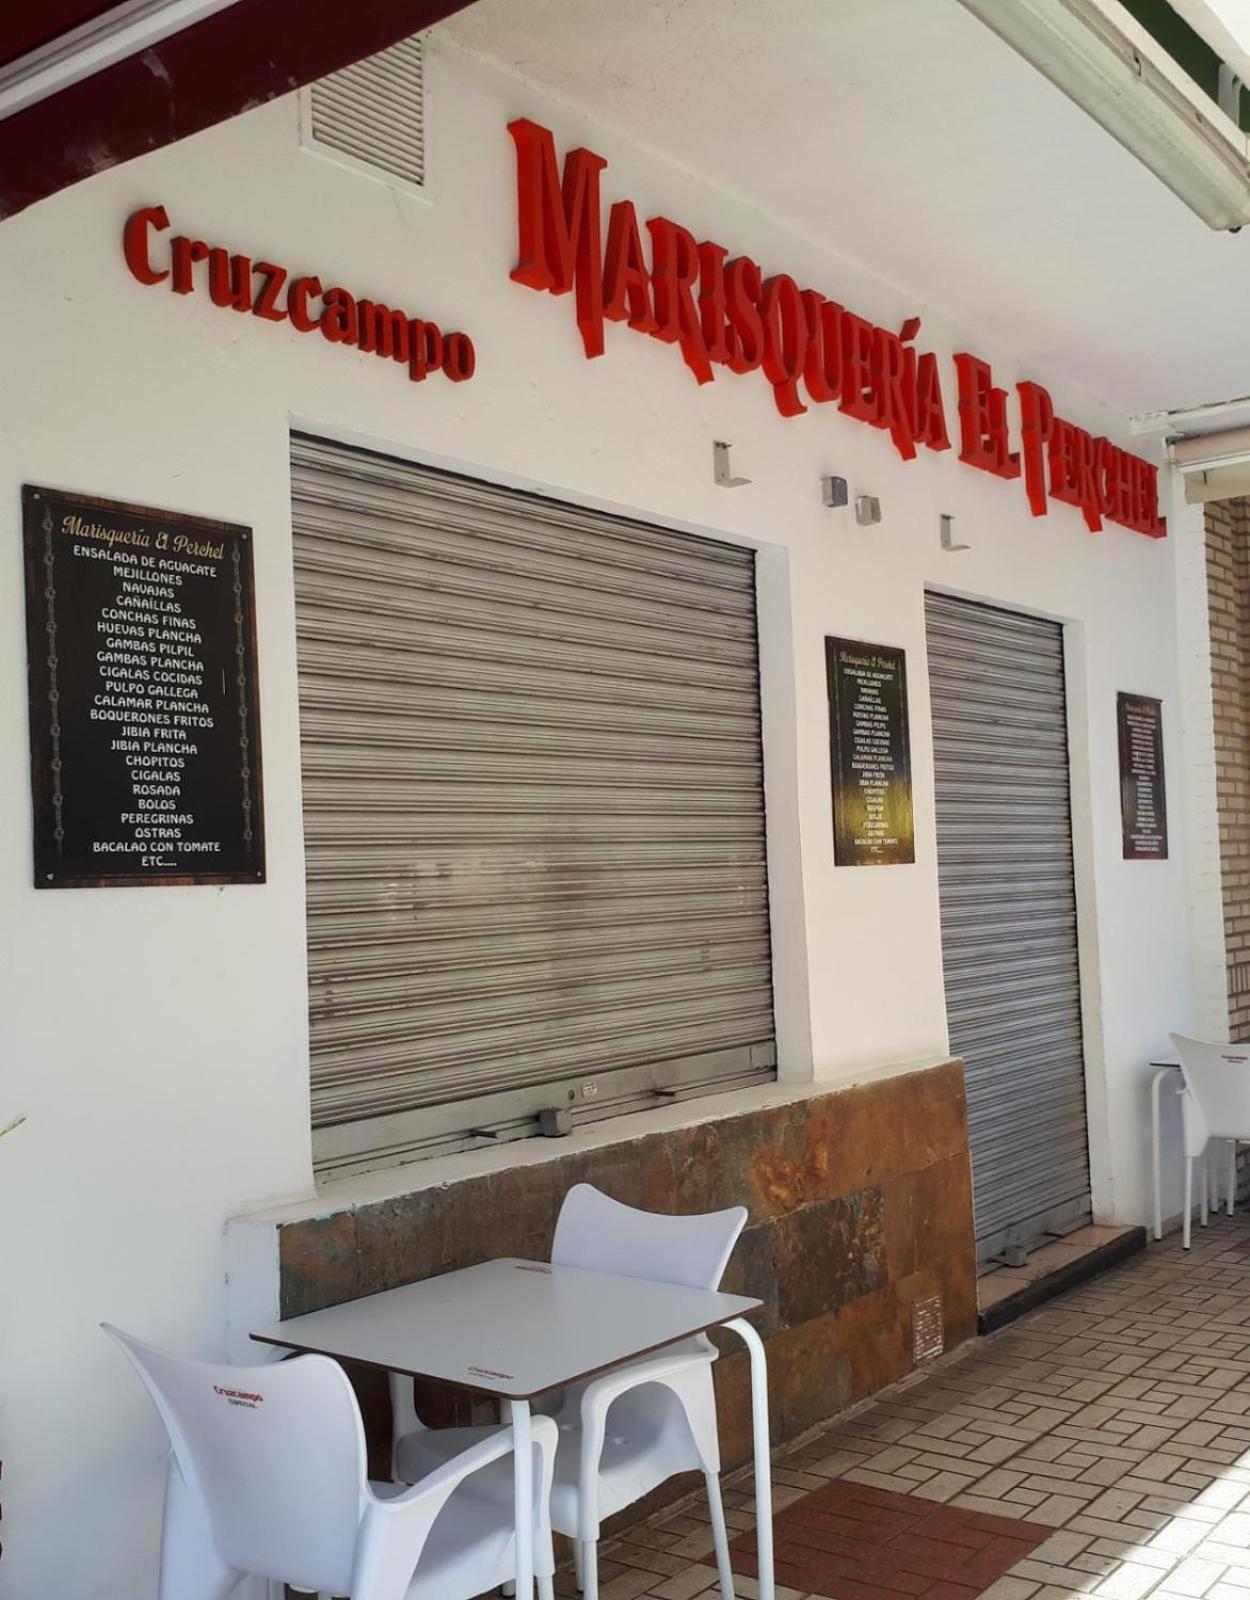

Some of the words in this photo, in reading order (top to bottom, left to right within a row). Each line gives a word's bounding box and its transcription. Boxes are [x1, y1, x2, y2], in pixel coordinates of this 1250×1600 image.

[123, 206, 475, 383] Cruzcampo
[507, 118, 951, 460] MARISQUERÍA
[1016, 381, 1167, 539] PERCHEL
[61, 515, 150, 548] Marisquería
[173, 535, 224, 560] Perchel
[73, 545, 138, 565] ENSALADA
[141, 556, 156, 568] DE
[159, 560, 217, 578] AGUACATE
[113, 566, 183, 586] MEJILLONES
[122, 582, 175, 599] NAVAJAS
[101, 608, 159, 624] CONCHAS
[162, 616, 196, 630] FINAS
[97, 621, 145, 637] HUEVAS
[148, 627, 202, 644] PLANCHA
[106, 637, 156, 652] GAMBAS
[159, 643, 195, 657] PILPIL
[96, 651, 147, 666] GAMBAS
[150, 656, 204, 672] PLANCHA
[99, 666, 150, 681] CIGALAS
[153, 671, 203, 685] COCIDAS
[106, 681, 145, 694] PULPO
[147, 685, 198, 698] GALLEGA
[94, 695, 153, 709] CALAMAR
[155, 700, 210, 714] PLANCHA
[90, 709, 171, 725] BOQUERONES
[173, 715, 214, 728] FRITOS
[121, 726, 151, 738] JIBIA
[153, 728, 187, 740] FRITA
[110, 740, 141, 751] JIBIA
[143, 741, 198, 755] PLANCHA
[125, 755, 186, 768] CHOPITOS
[130, 770, 181, 782] CIGALAS
[132, 784, 181, 796] ROSADA
[138, 799, 177, 810] BOLOS
[121, 813, 194, 825] PEREGRINAS
[134, 828, 182, 839] OSTRAS
[92, 842, 148, 853] BACALAO
[149, 842, 174, 852] CON
[177, 842, 221, 853] TOMATE
